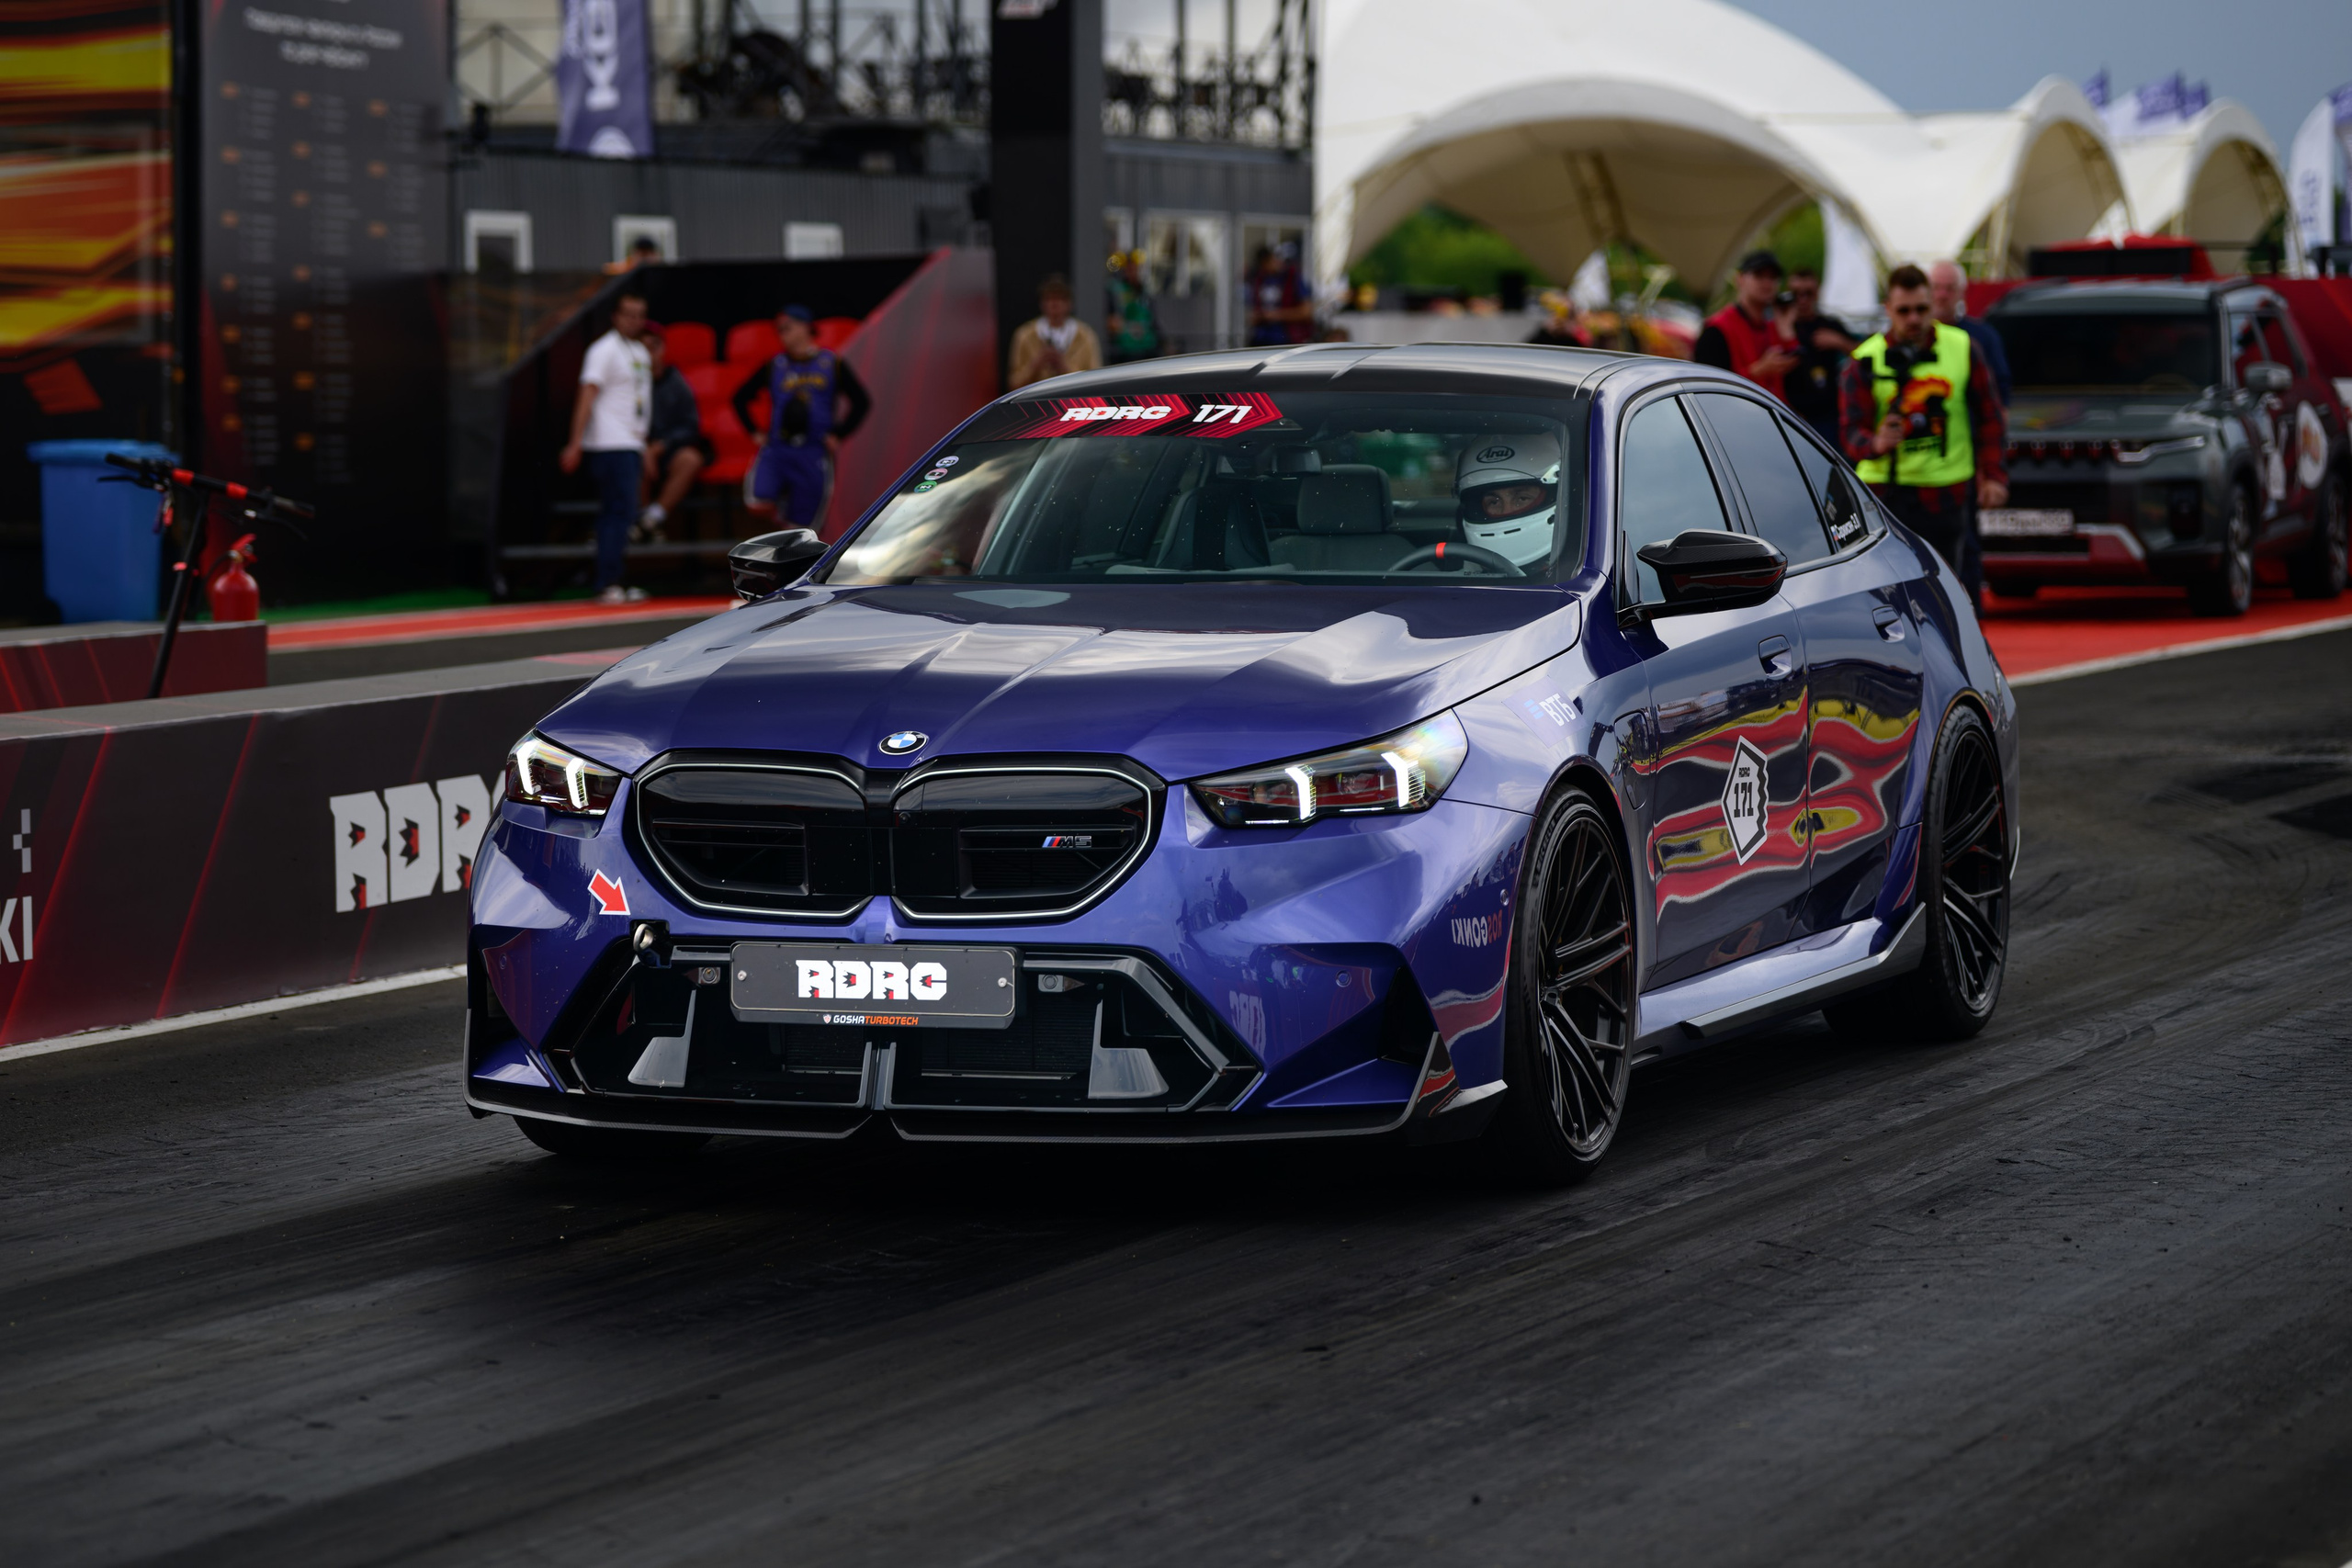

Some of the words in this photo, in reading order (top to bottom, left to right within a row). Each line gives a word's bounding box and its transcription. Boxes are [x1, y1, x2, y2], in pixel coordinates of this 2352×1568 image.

[1059, 406, 1172, 422] RDRC
[1193, 404, 1252, 423] 171
[1481, 447, 1510, 459] Arai
[1539, 693, 1577, 727] ВТБ
[1734, 782, 1754, 818] 171
[329, 770, 507, 913] RDR
[796, 960, 947, 1000] RDRC
[833, 1015, 919, 1026] GOSHATURBOTECH
